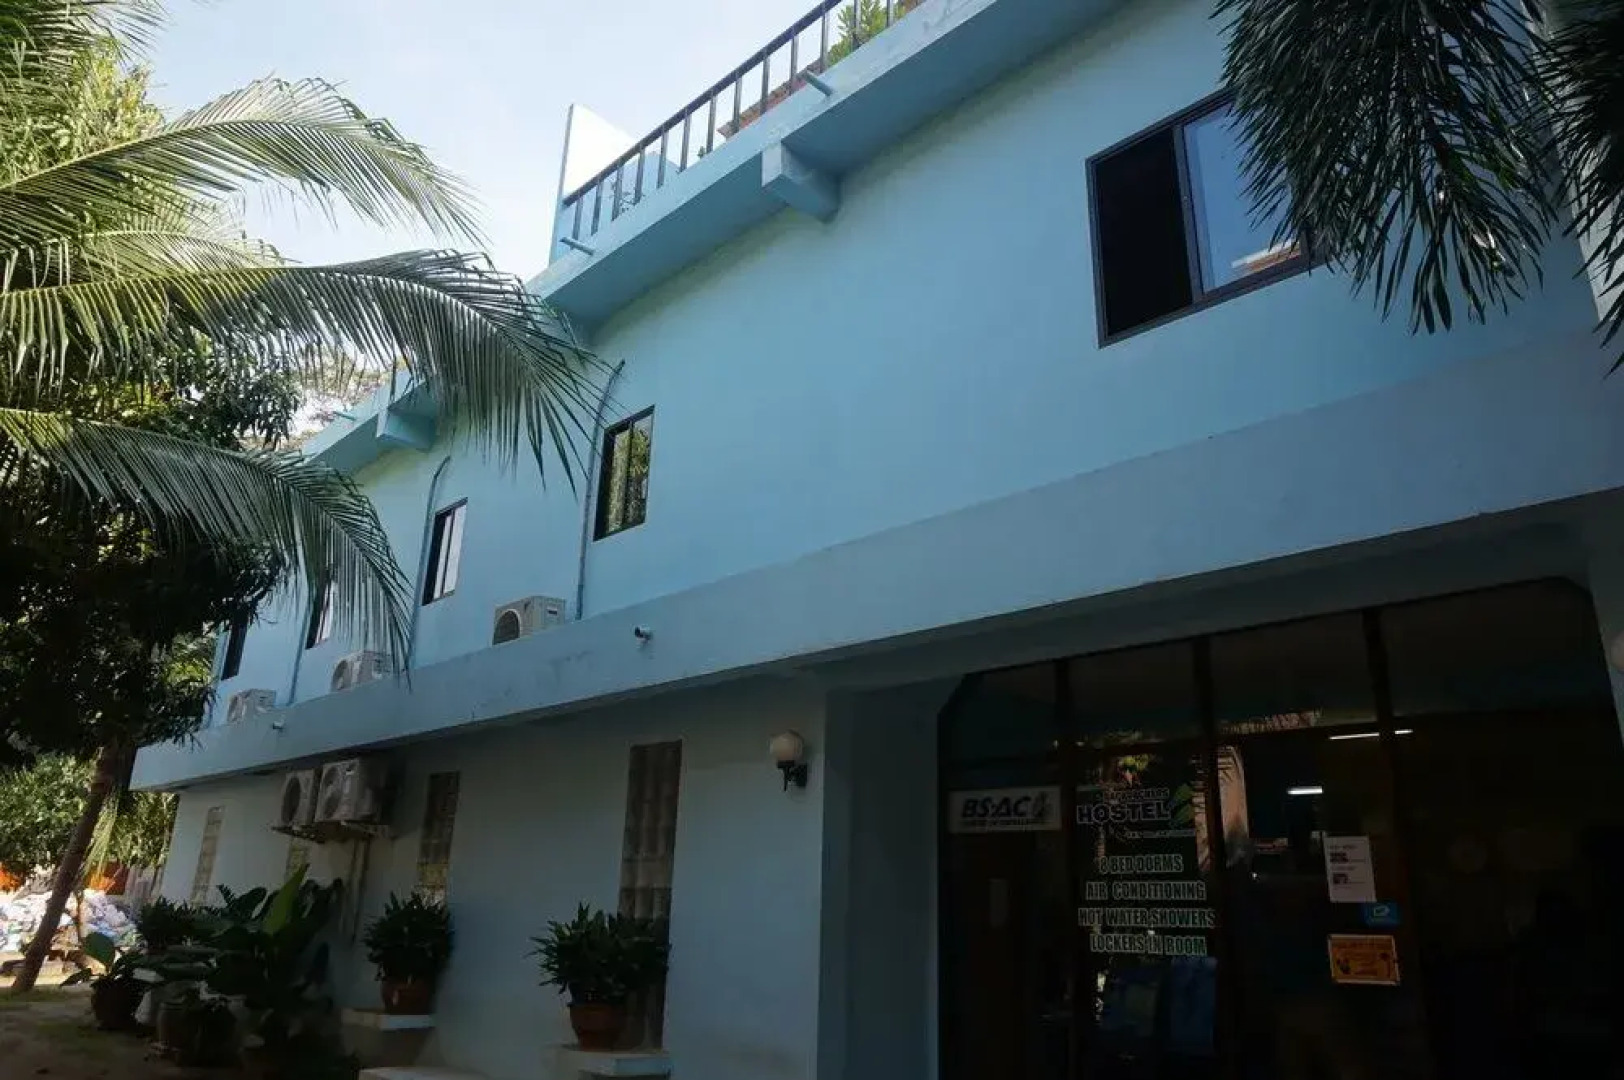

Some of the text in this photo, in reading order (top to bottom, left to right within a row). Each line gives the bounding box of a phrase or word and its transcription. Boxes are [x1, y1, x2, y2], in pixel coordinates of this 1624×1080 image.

[1076, 800, 1171, 824] HOSTEL
[1109, 855, 1135, 875] BED
[1135, 853, 1184, 873] DORMS
[1085, 879, 1208, 901] AIR CONDITIONING
[1077, 907, 1217, 929] HOT WATER SHOWERS
[1089, 934, 1209, 956] LOCKERS IN ROOM
